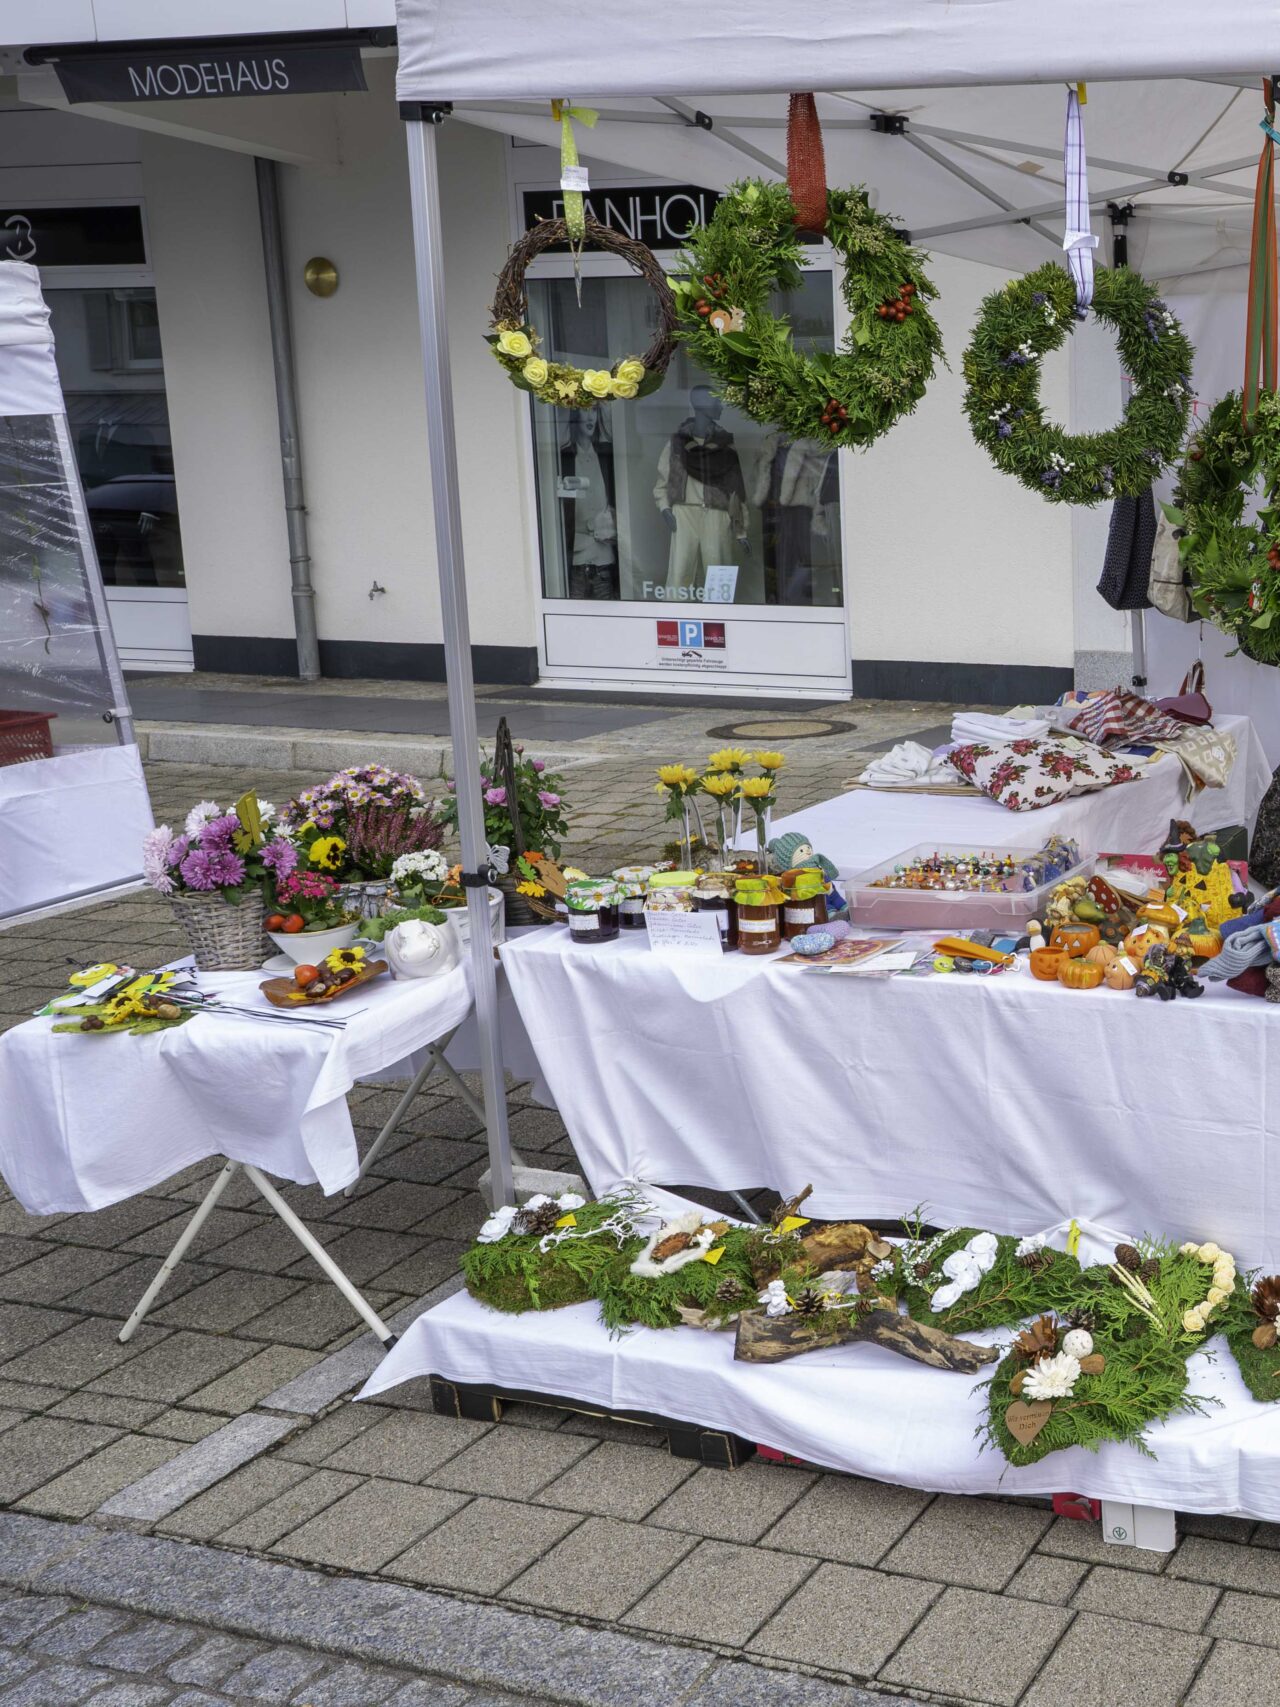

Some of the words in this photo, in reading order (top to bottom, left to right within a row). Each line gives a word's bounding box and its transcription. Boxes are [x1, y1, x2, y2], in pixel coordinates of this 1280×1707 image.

[128, 58, 289, 97] MODEHAUS
[642, 580, 715, 601] Fenster
[721, 583, 731, 601] 8
[685, 623, 698, 645] P
[1019, 1421, 1036, 1430] Dich
